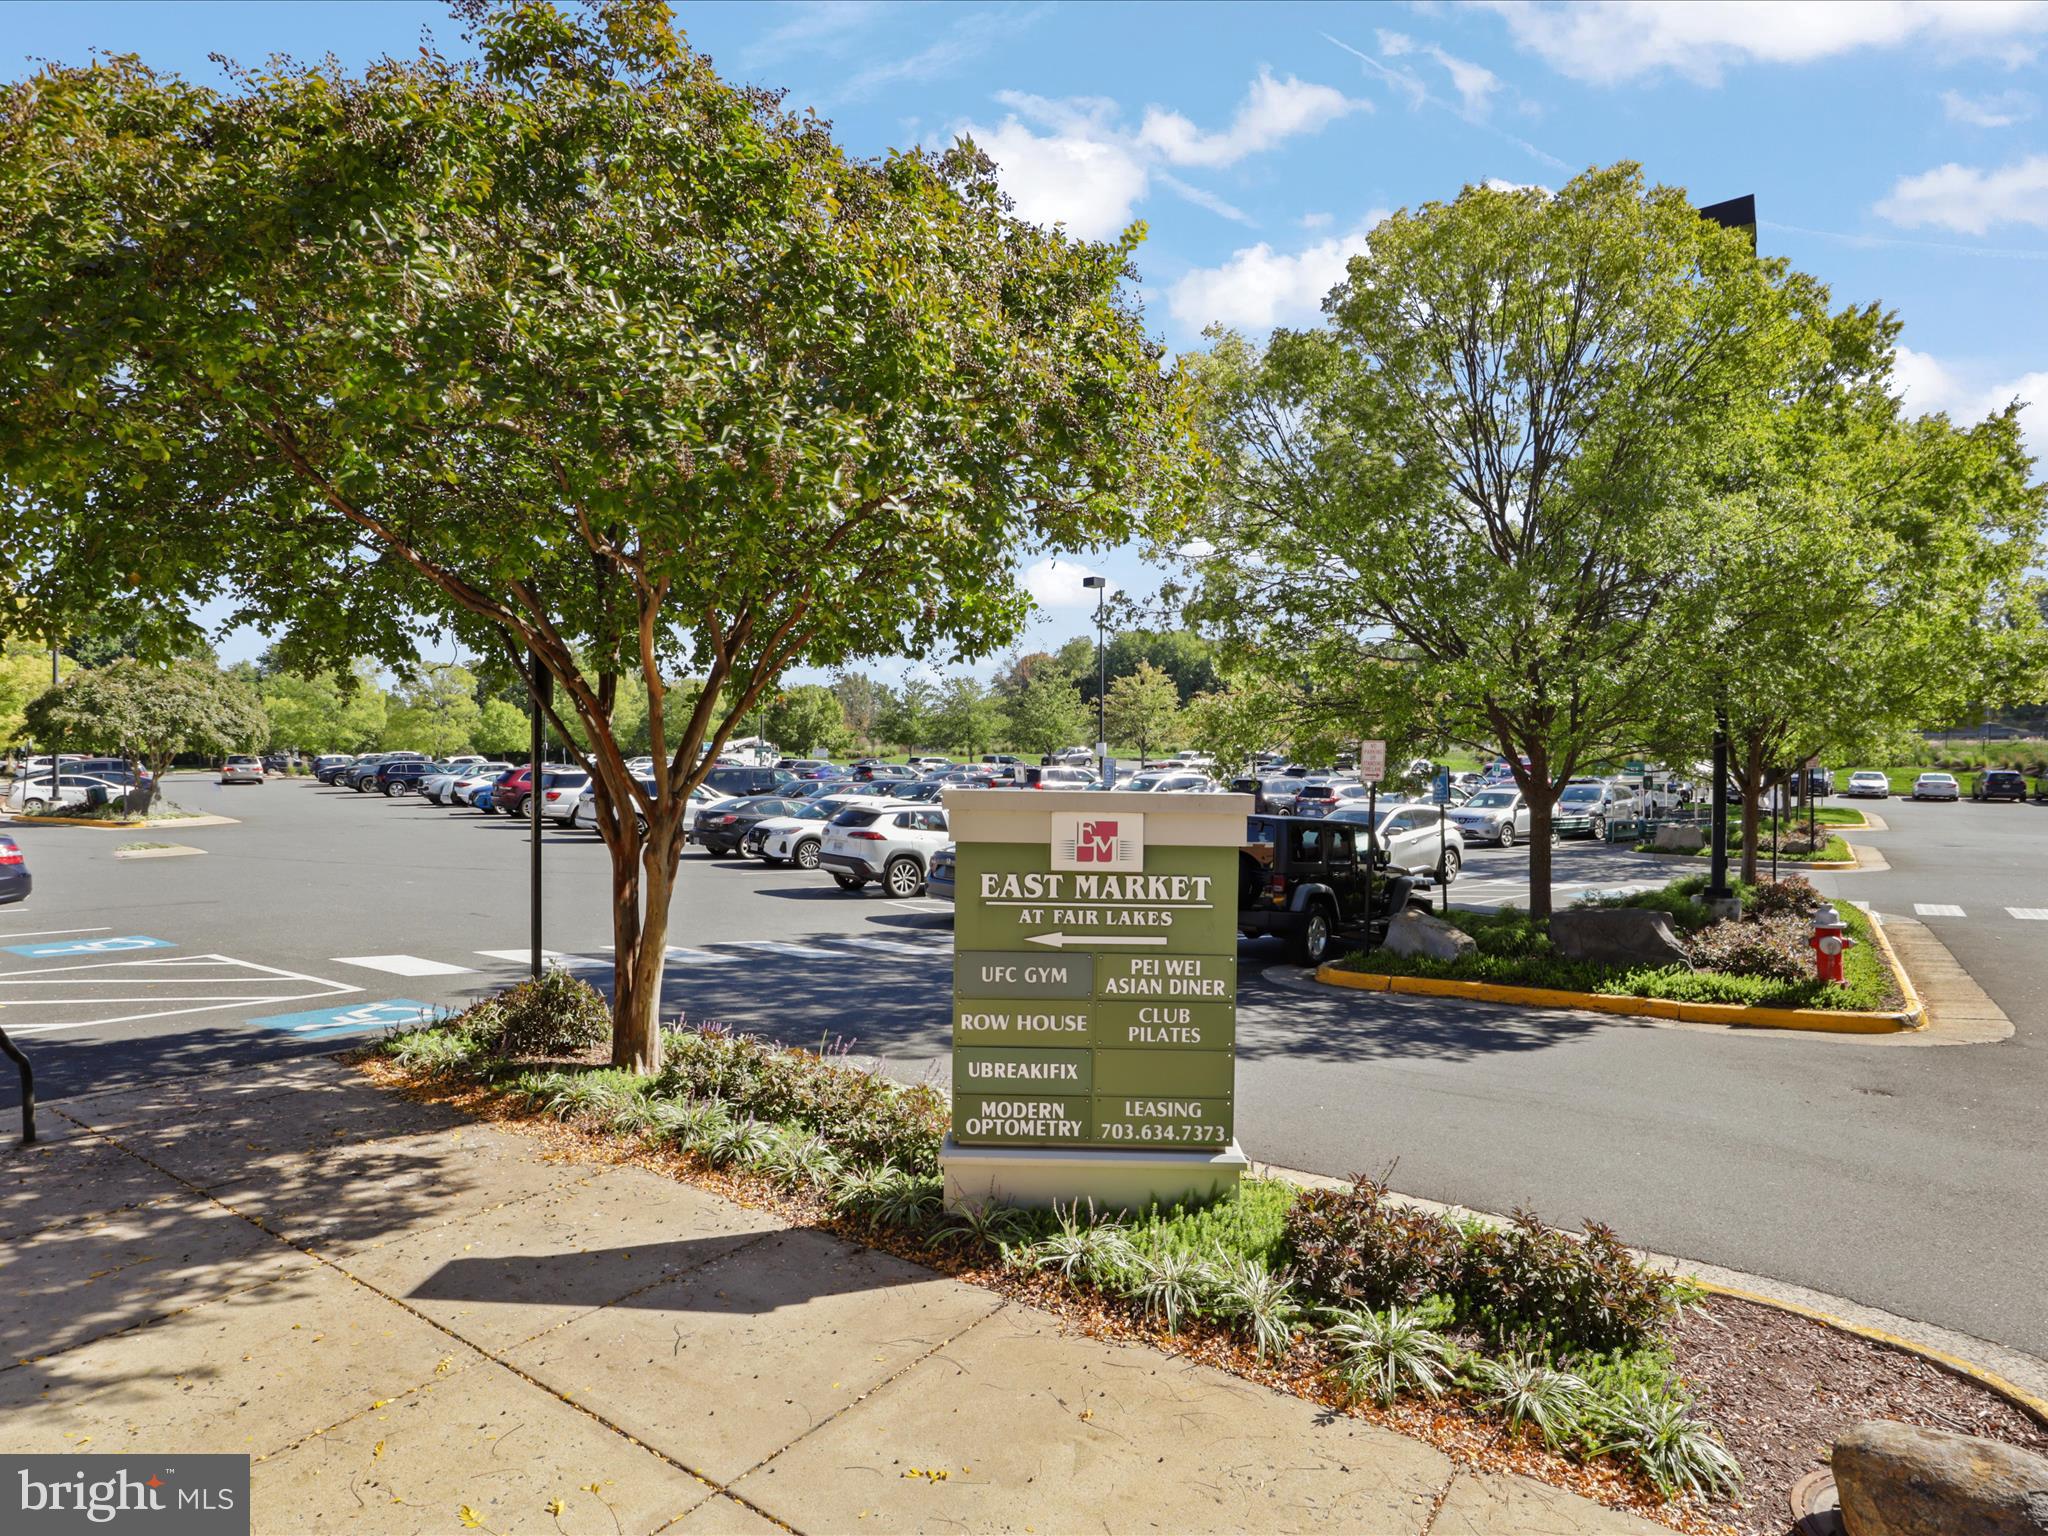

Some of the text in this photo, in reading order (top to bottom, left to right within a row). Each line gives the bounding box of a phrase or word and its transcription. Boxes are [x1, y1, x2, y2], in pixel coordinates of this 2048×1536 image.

[980, 873, 1212, 901] EAST MARKET
[1018, 909, 1174, 927] AT FAIR LAKES
[981, 966, 1068, 984] UFC GYM
[1131, 959, 1201, 977] PEI WEI
[1105, 977, 1225, 996] ASIAN DINER
[961, 1013, 1088, 1032] ROW HOUSE
[1138, 1007, 1191, 1024] CLUB
[1128, 1027, 1201, 1044] PILATES
[968, 1062, 1078, 1080] UBREAKIFIX
[981, 1101, 1065, 1119] MODERN
[1125, 1101, 1202, 1118] LEASING
[965, 1118, 1082, 1138] OPTOMETRY
[1101, 1123, 1225, 1142] 703.634.7373
